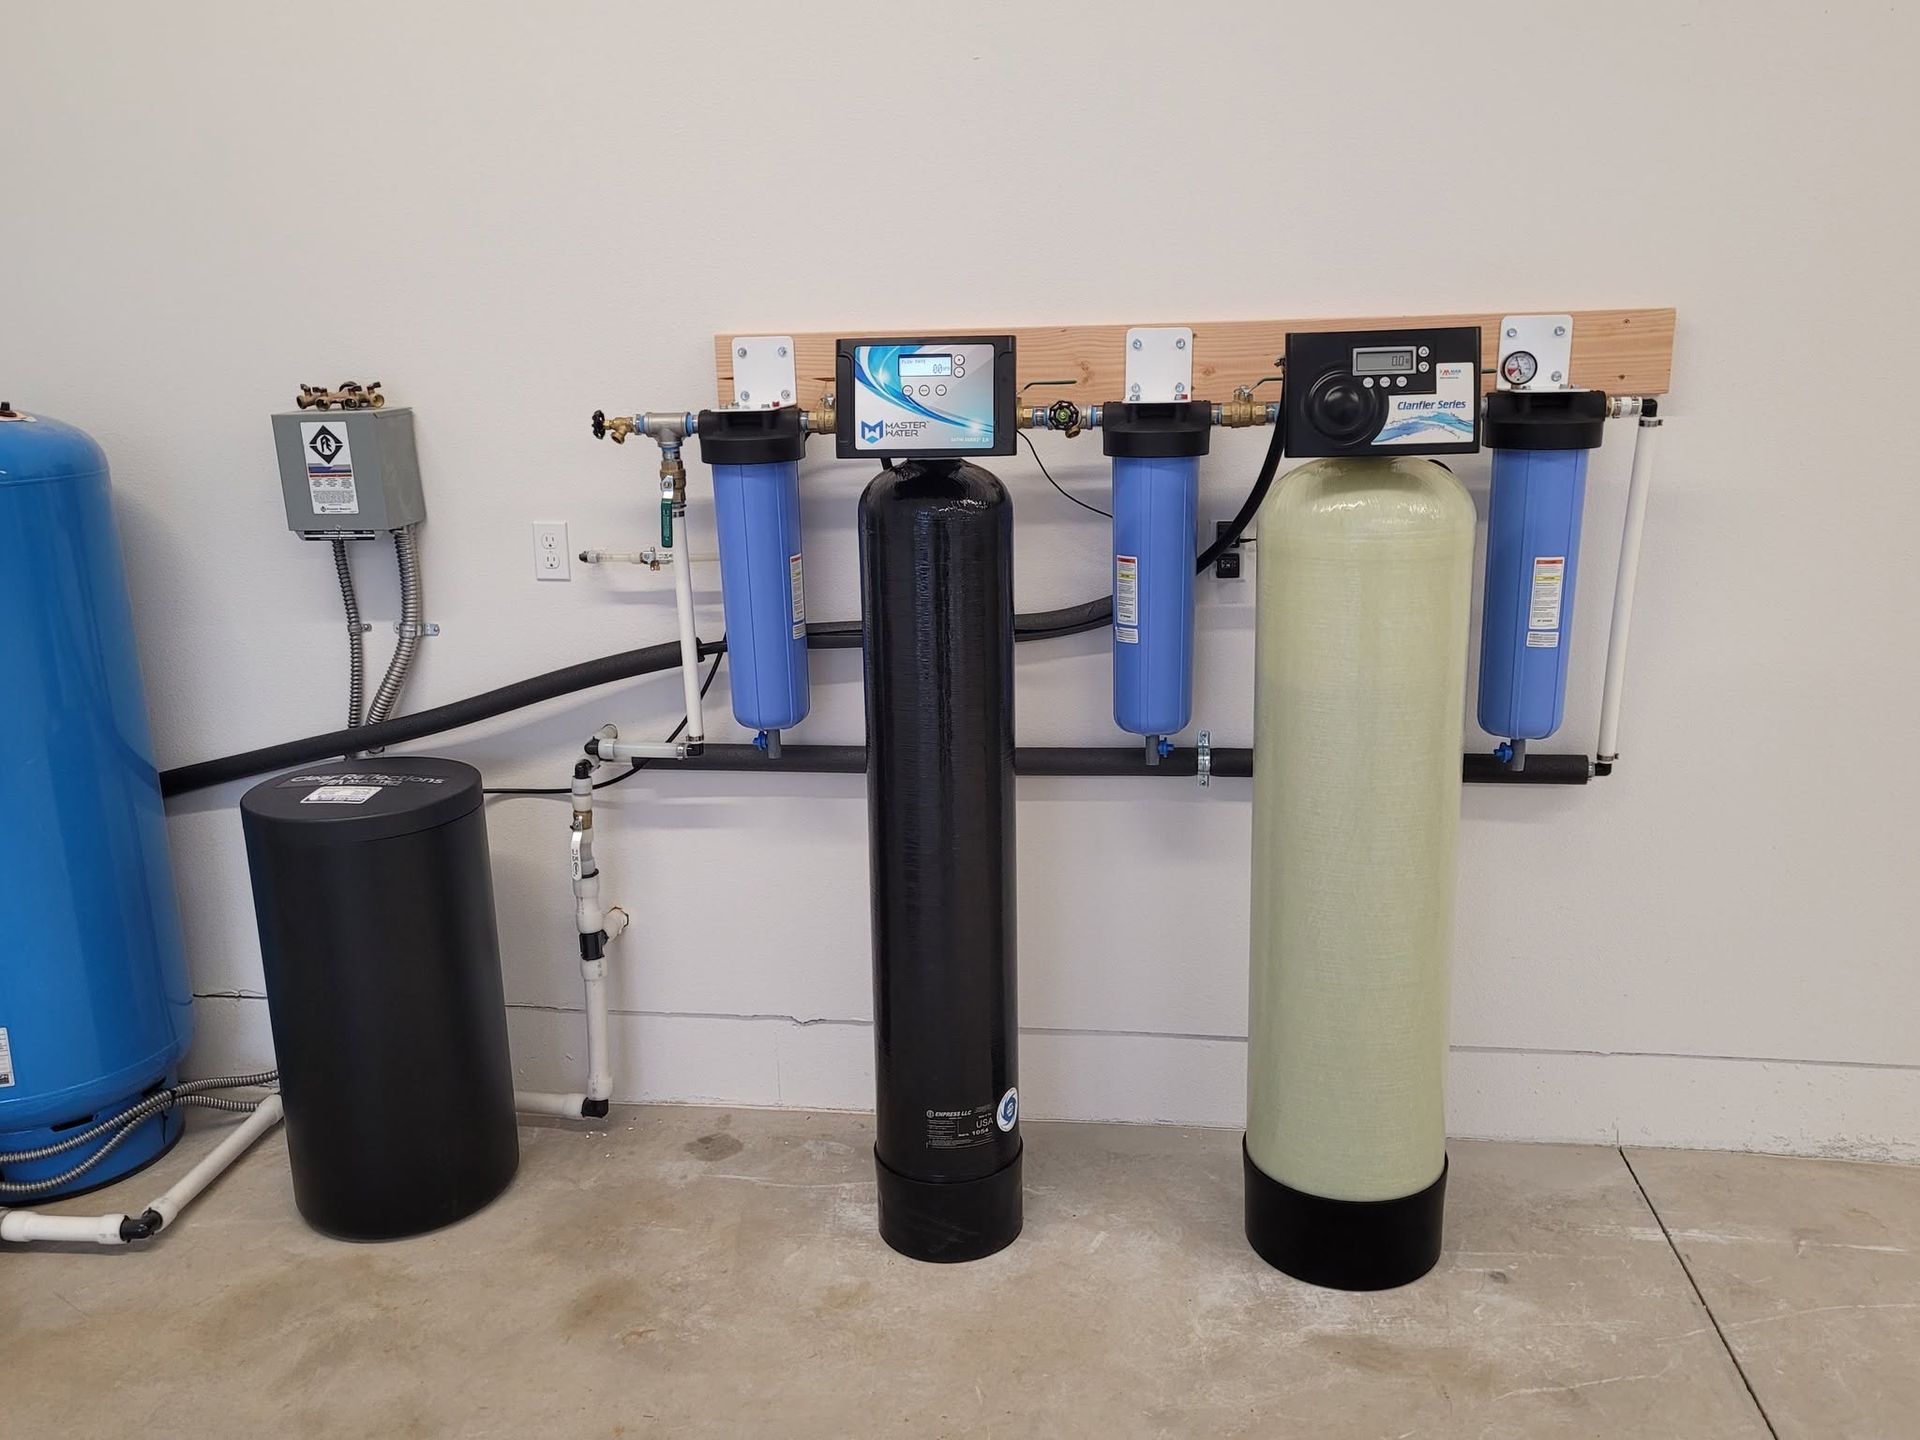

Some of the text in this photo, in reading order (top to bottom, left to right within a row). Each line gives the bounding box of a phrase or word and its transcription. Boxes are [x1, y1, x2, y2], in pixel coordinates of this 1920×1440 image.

[1397, 399, 1466, 410] Clarifier Series
[885, 421, 927, 430] MASTER
[885, 429, 919, 437] WATER
[976, 1117, 993, 1128] USA
